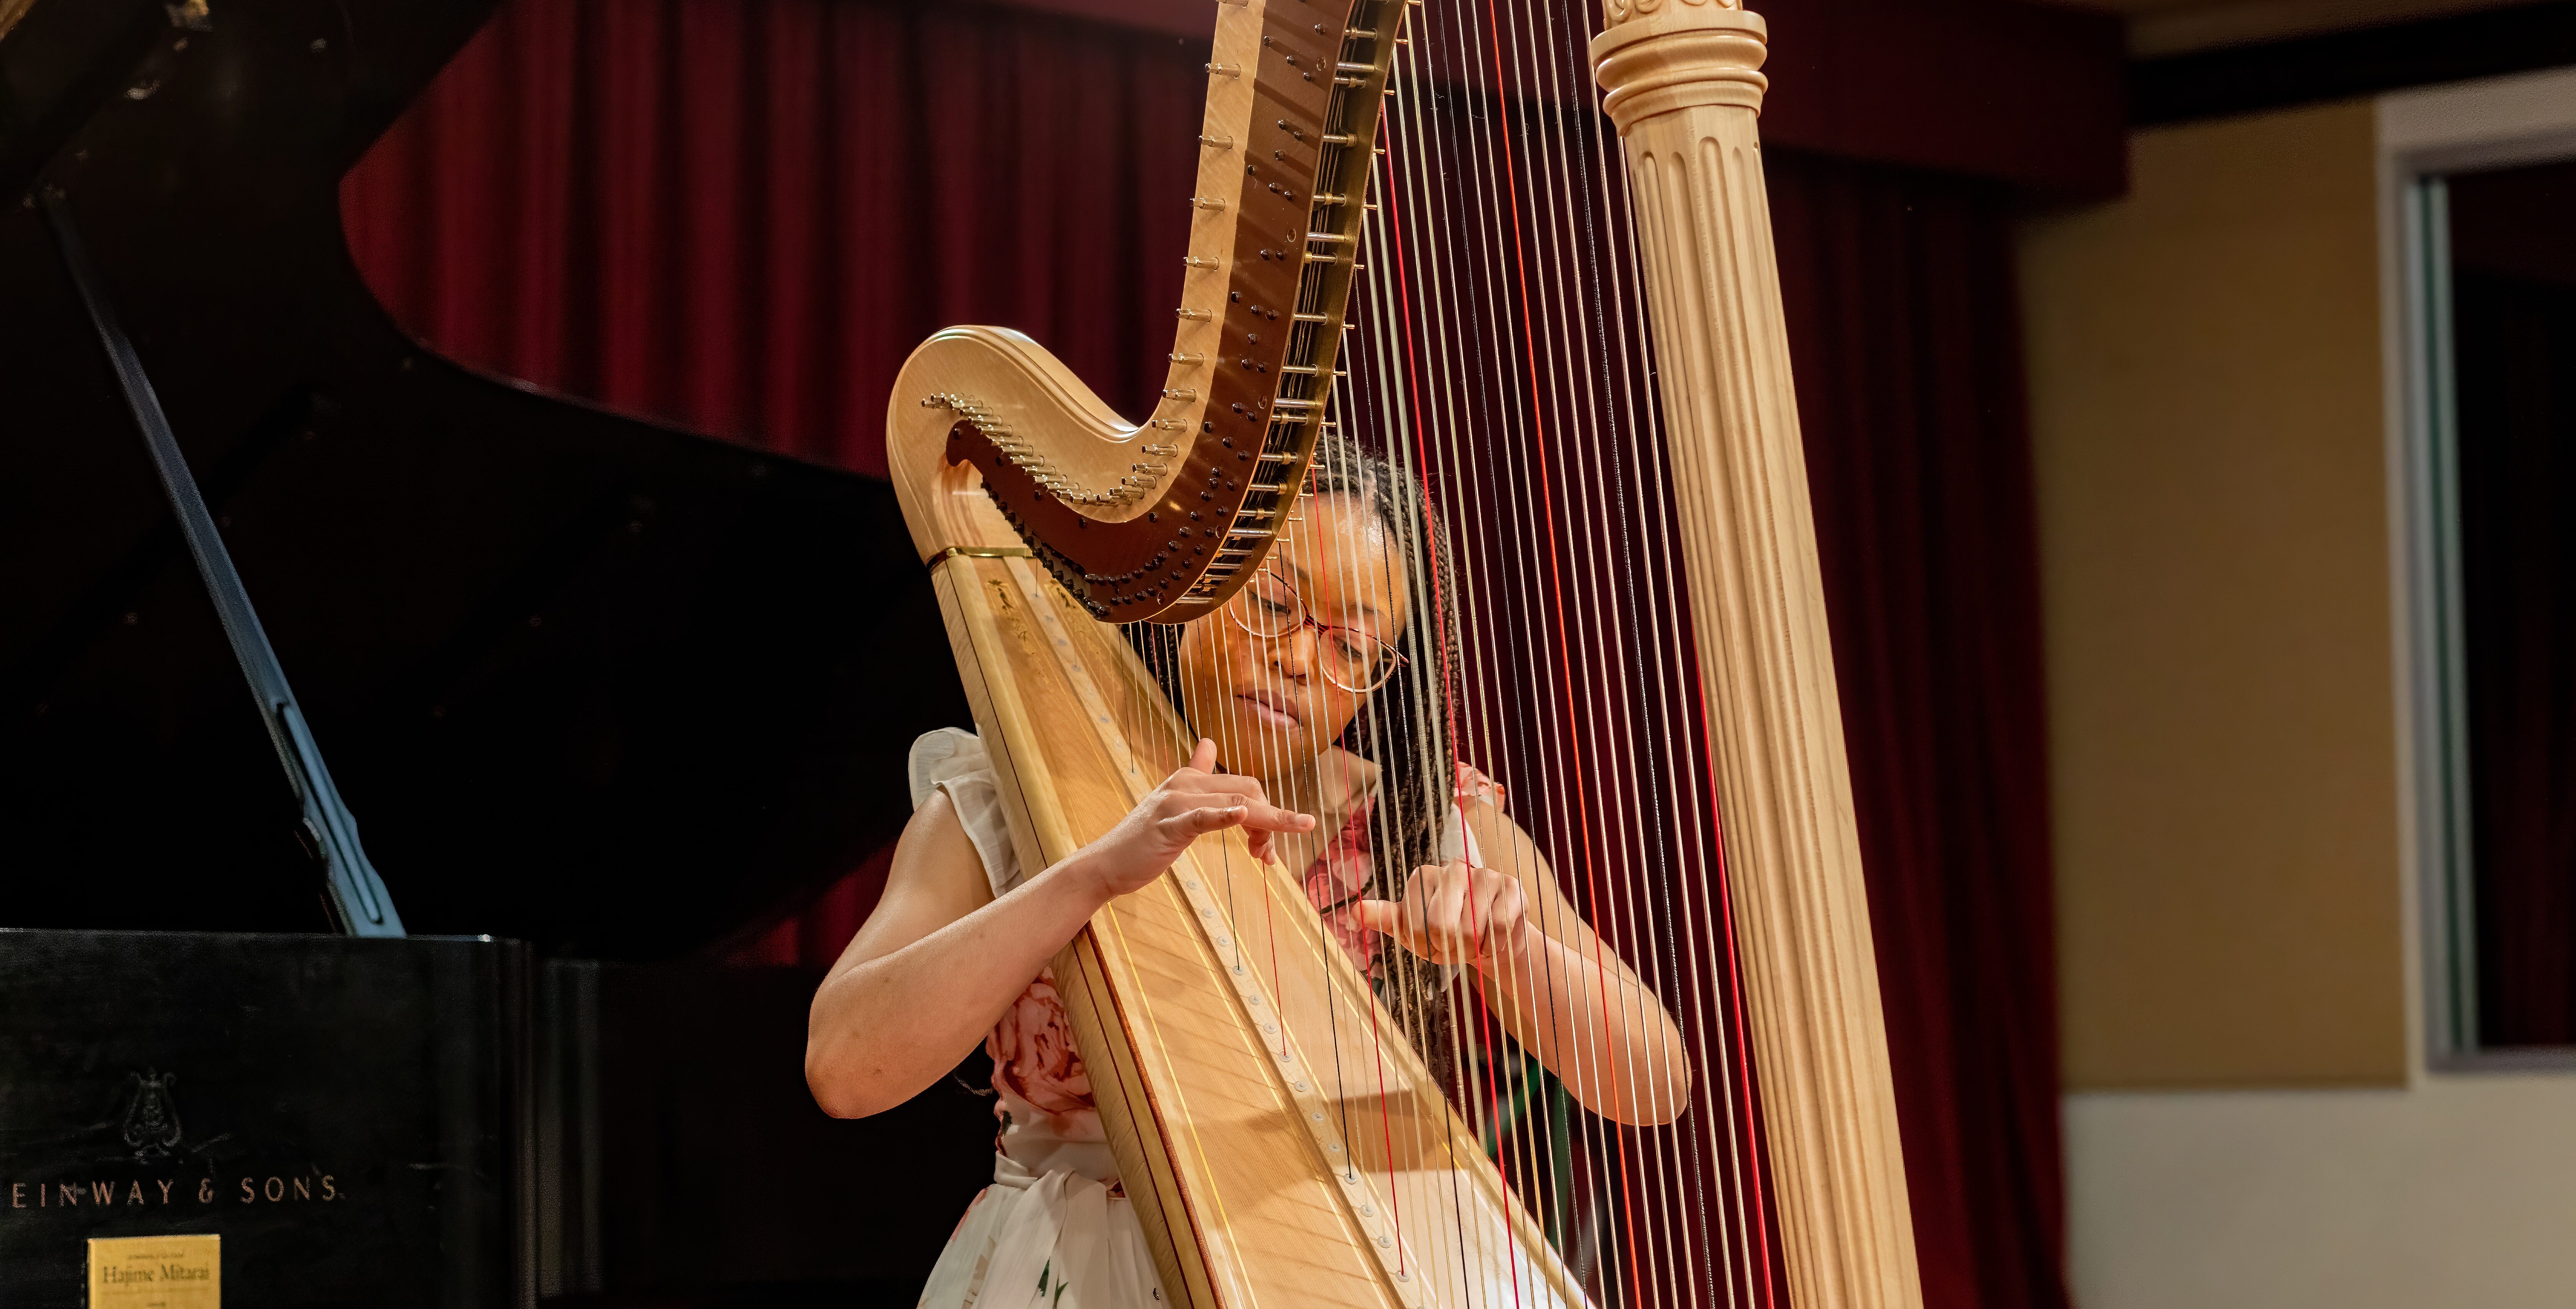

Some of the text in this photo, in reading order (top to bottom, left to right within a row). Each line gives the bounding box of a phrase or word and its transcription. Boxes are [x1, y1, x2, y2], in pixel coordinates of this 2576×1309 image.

[13, 1175, 335, 1207] EINWAY & SONS
